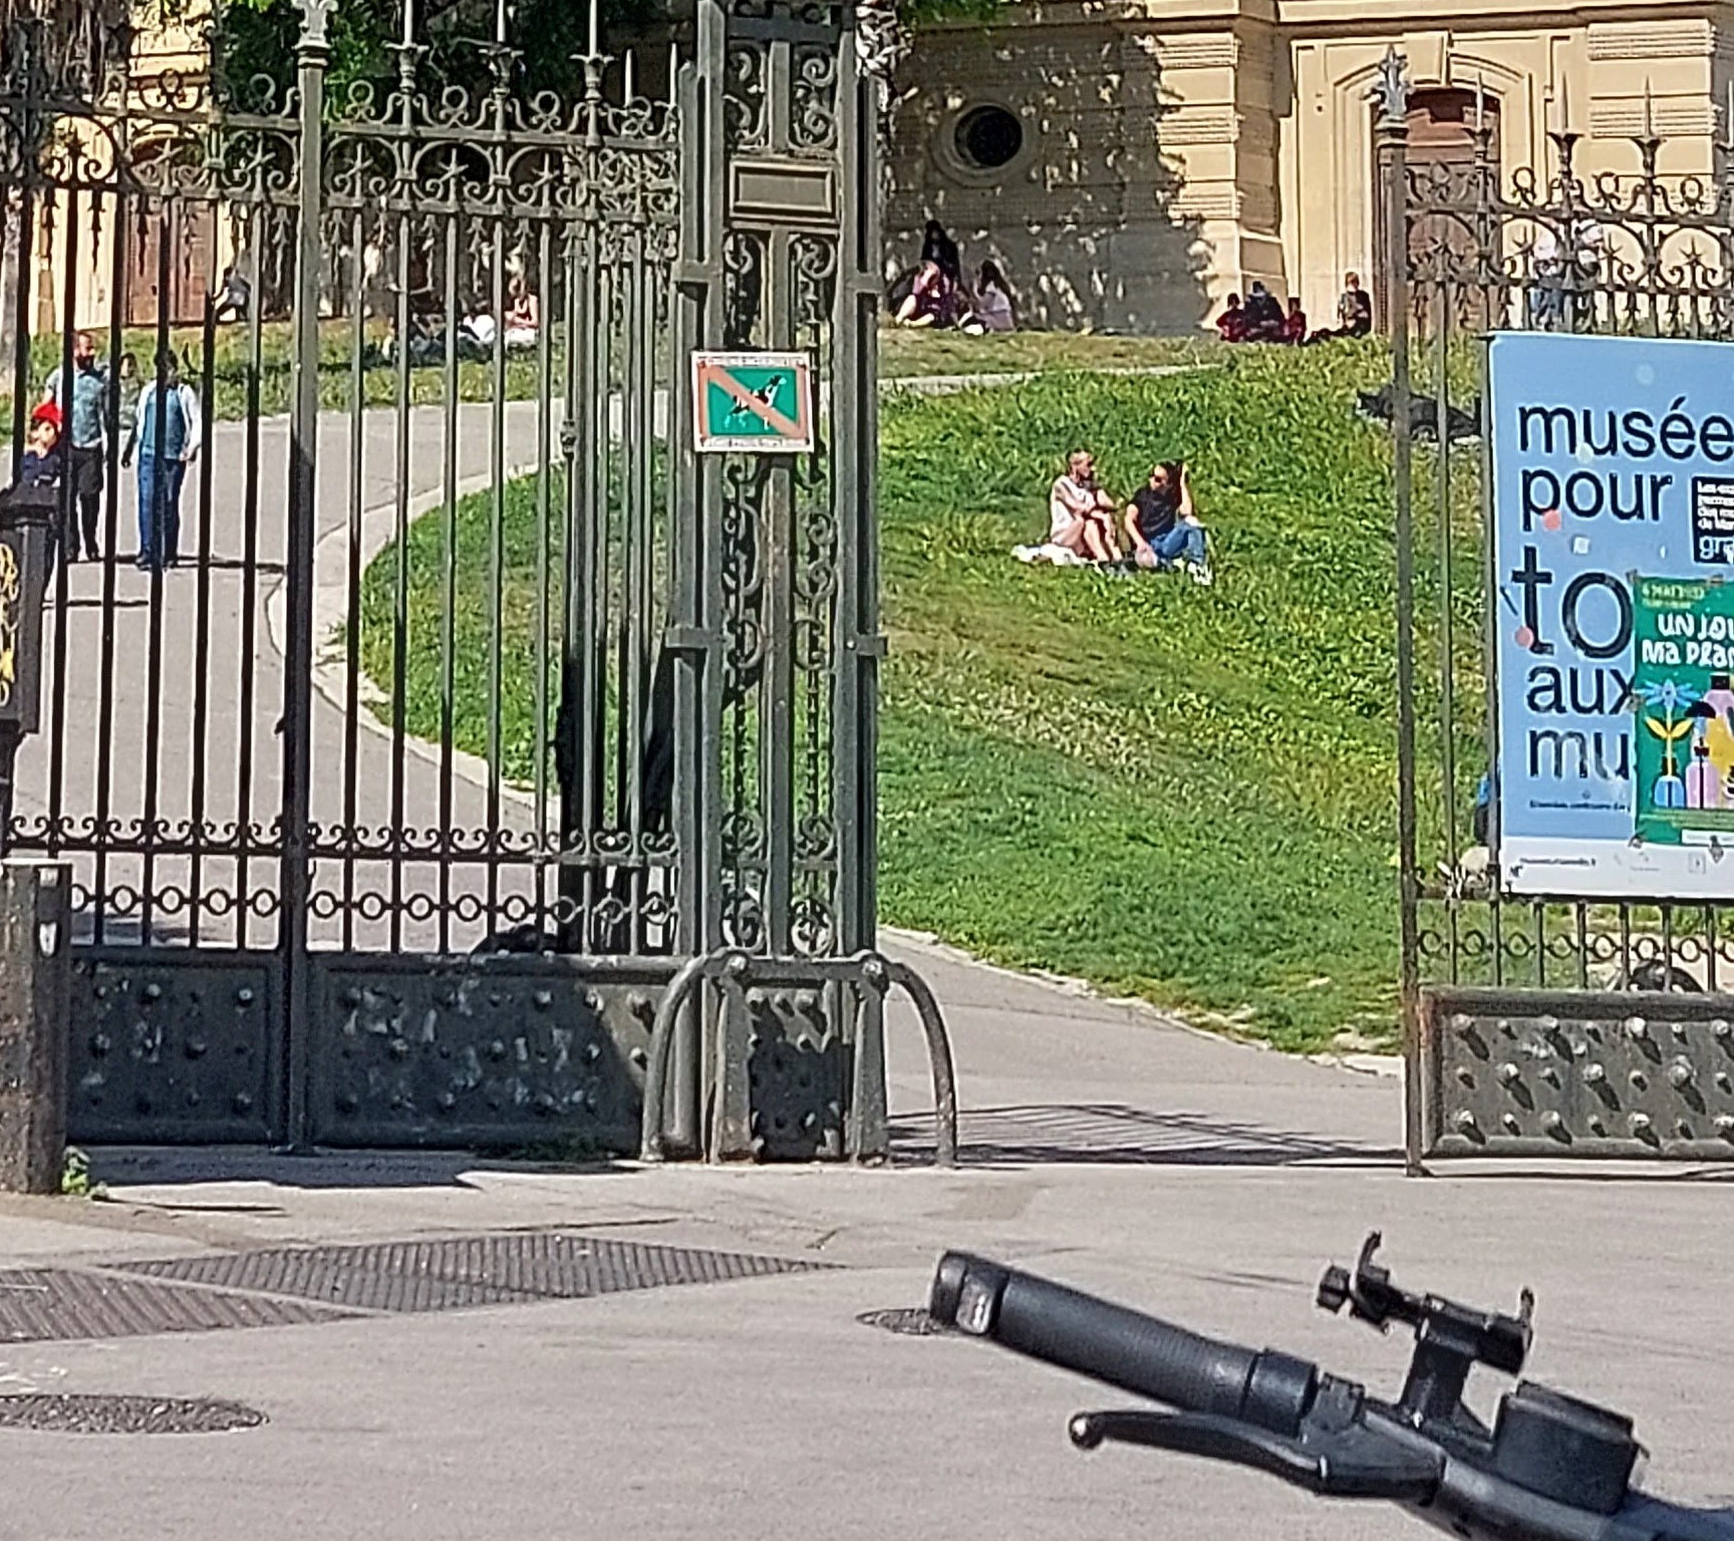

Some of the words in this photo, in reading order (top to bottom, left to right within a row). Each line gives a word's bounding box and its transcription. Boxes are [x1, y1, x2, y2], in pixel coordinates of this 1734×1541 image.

[1518, 396, 1734, 463] musée
[1521, 469, 1673, 533] pour
[1657, 613, 1695, 637] UN
